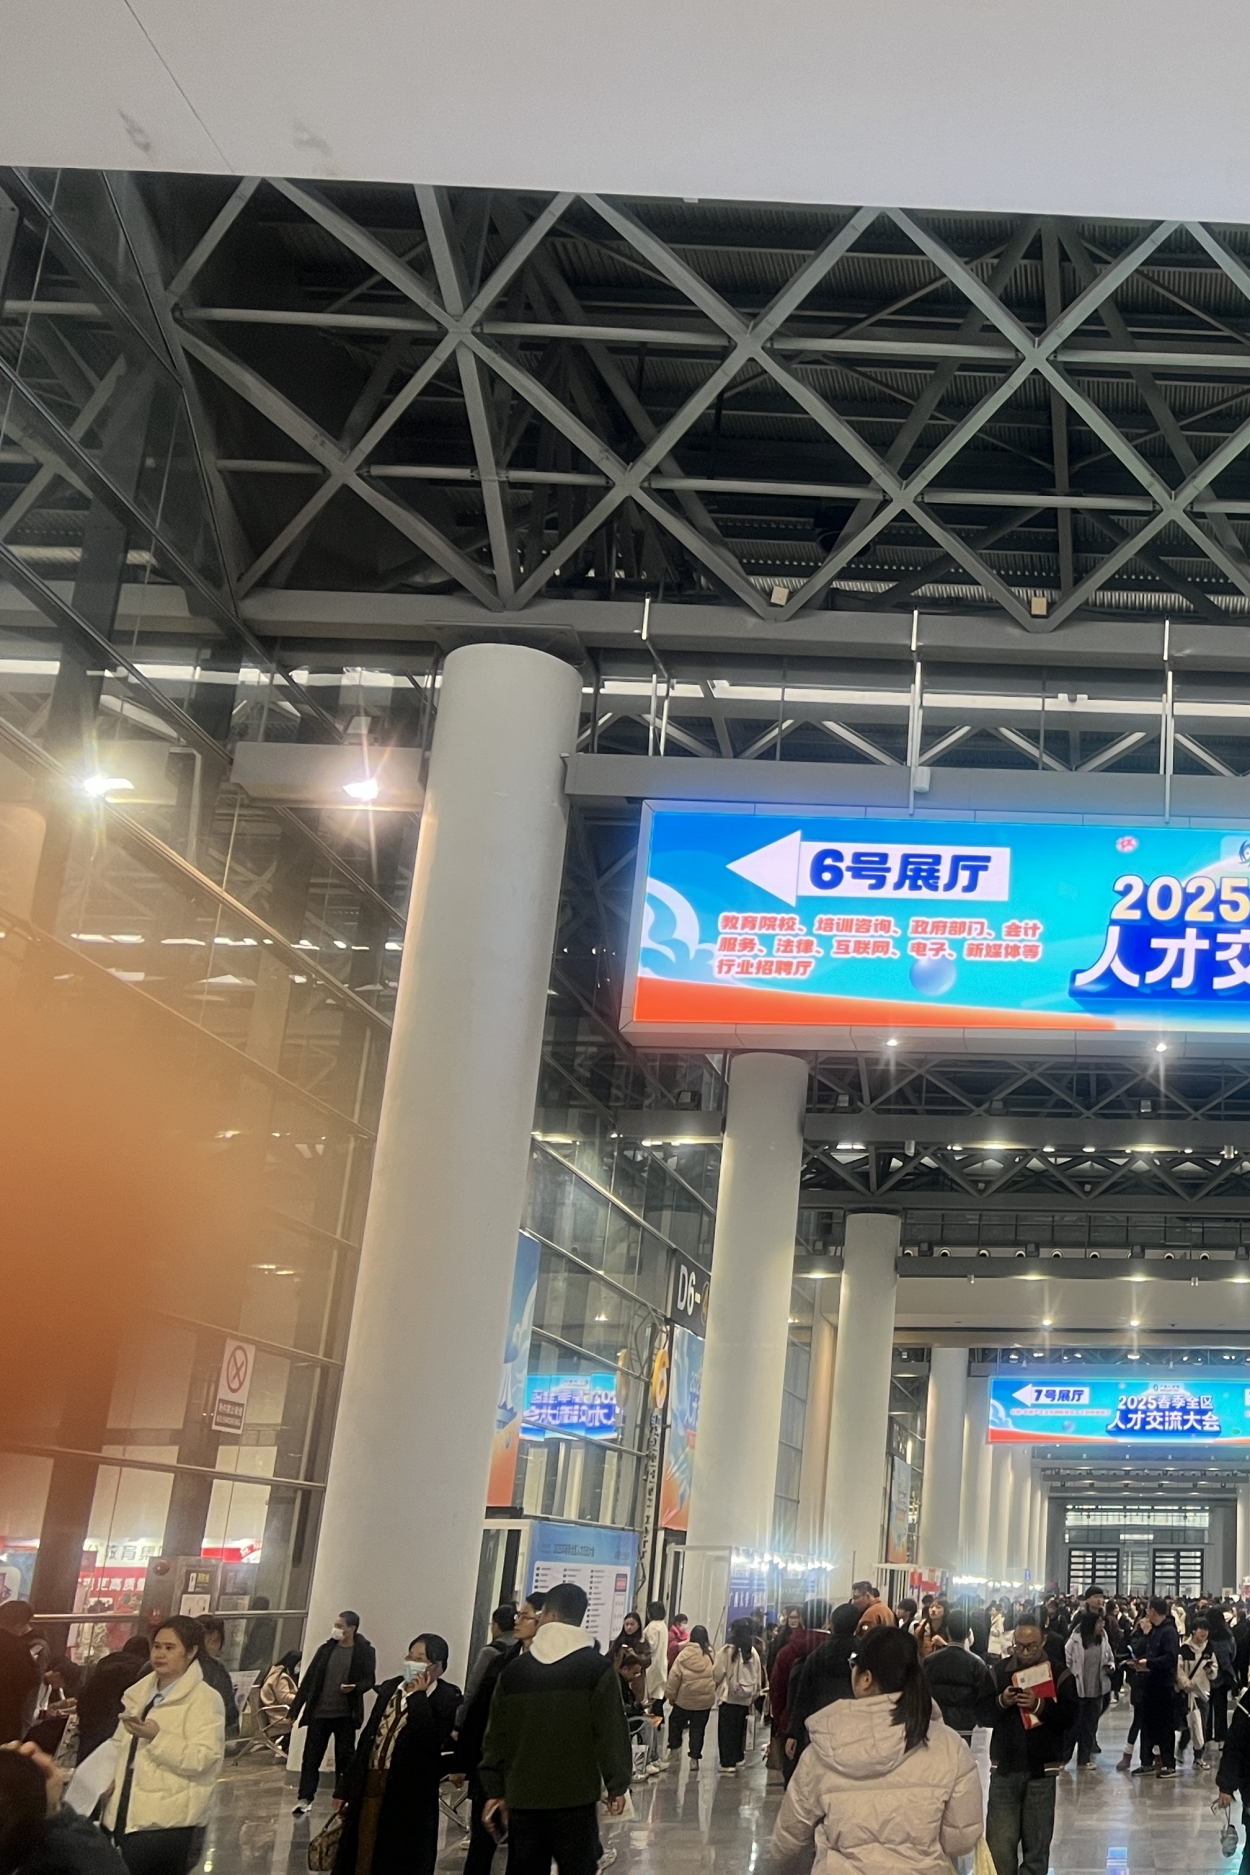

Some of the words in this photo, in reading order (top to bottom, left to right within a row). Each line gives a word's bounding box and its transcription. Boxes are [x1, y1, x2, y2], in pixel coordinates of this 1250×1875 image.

[808, 848, 992, 894] 6号展厅
[716, 958, 814, 977] 行业招聘厅
[1034, 1389, 1084, 1402] 7号展厅
[1117, 1395, 1214, 1410] 2025春季全区
[1106, 1410, 1220, 1431] 人才交流大会
